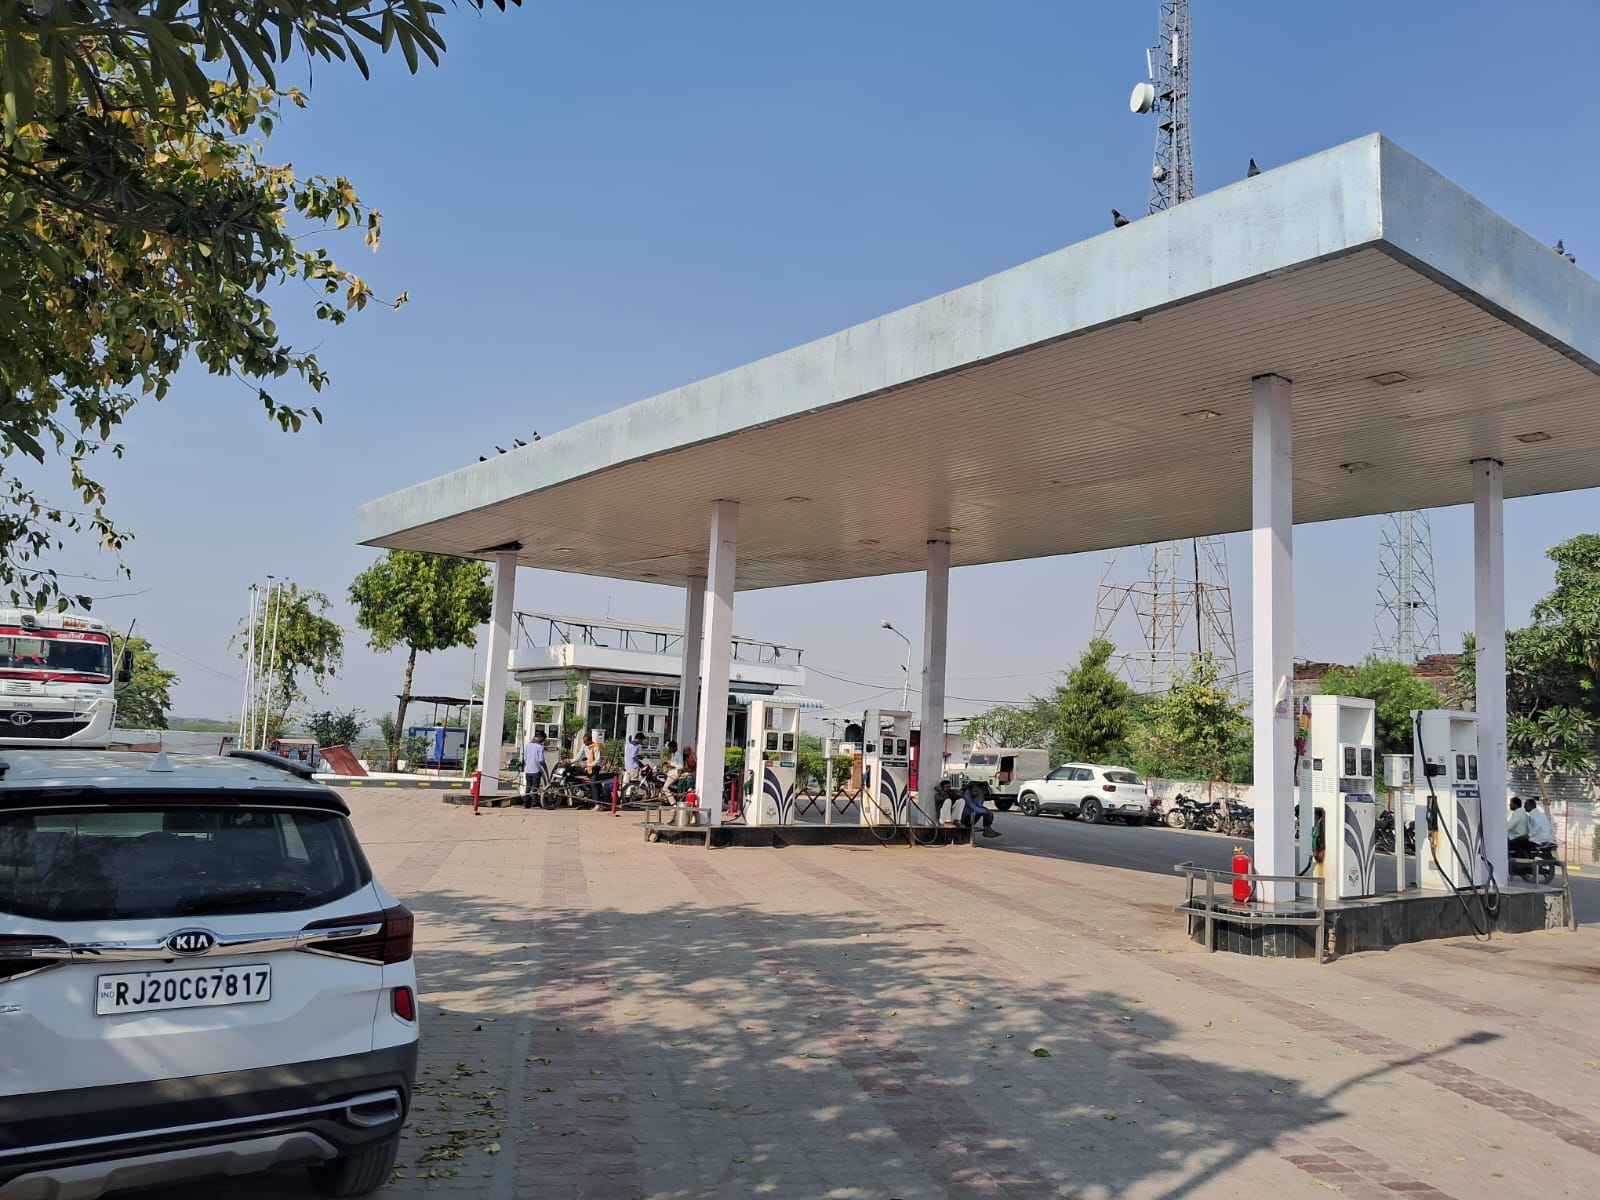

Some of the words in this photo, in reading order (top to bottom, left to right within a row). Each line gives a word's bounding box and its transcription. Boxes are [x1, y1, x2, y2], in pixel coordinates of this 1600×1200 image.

[176, 934, 209, 951] KIA
[100, 991, 115, 999] IND
[115, 971, 268, 1006] RJ20CG7817
